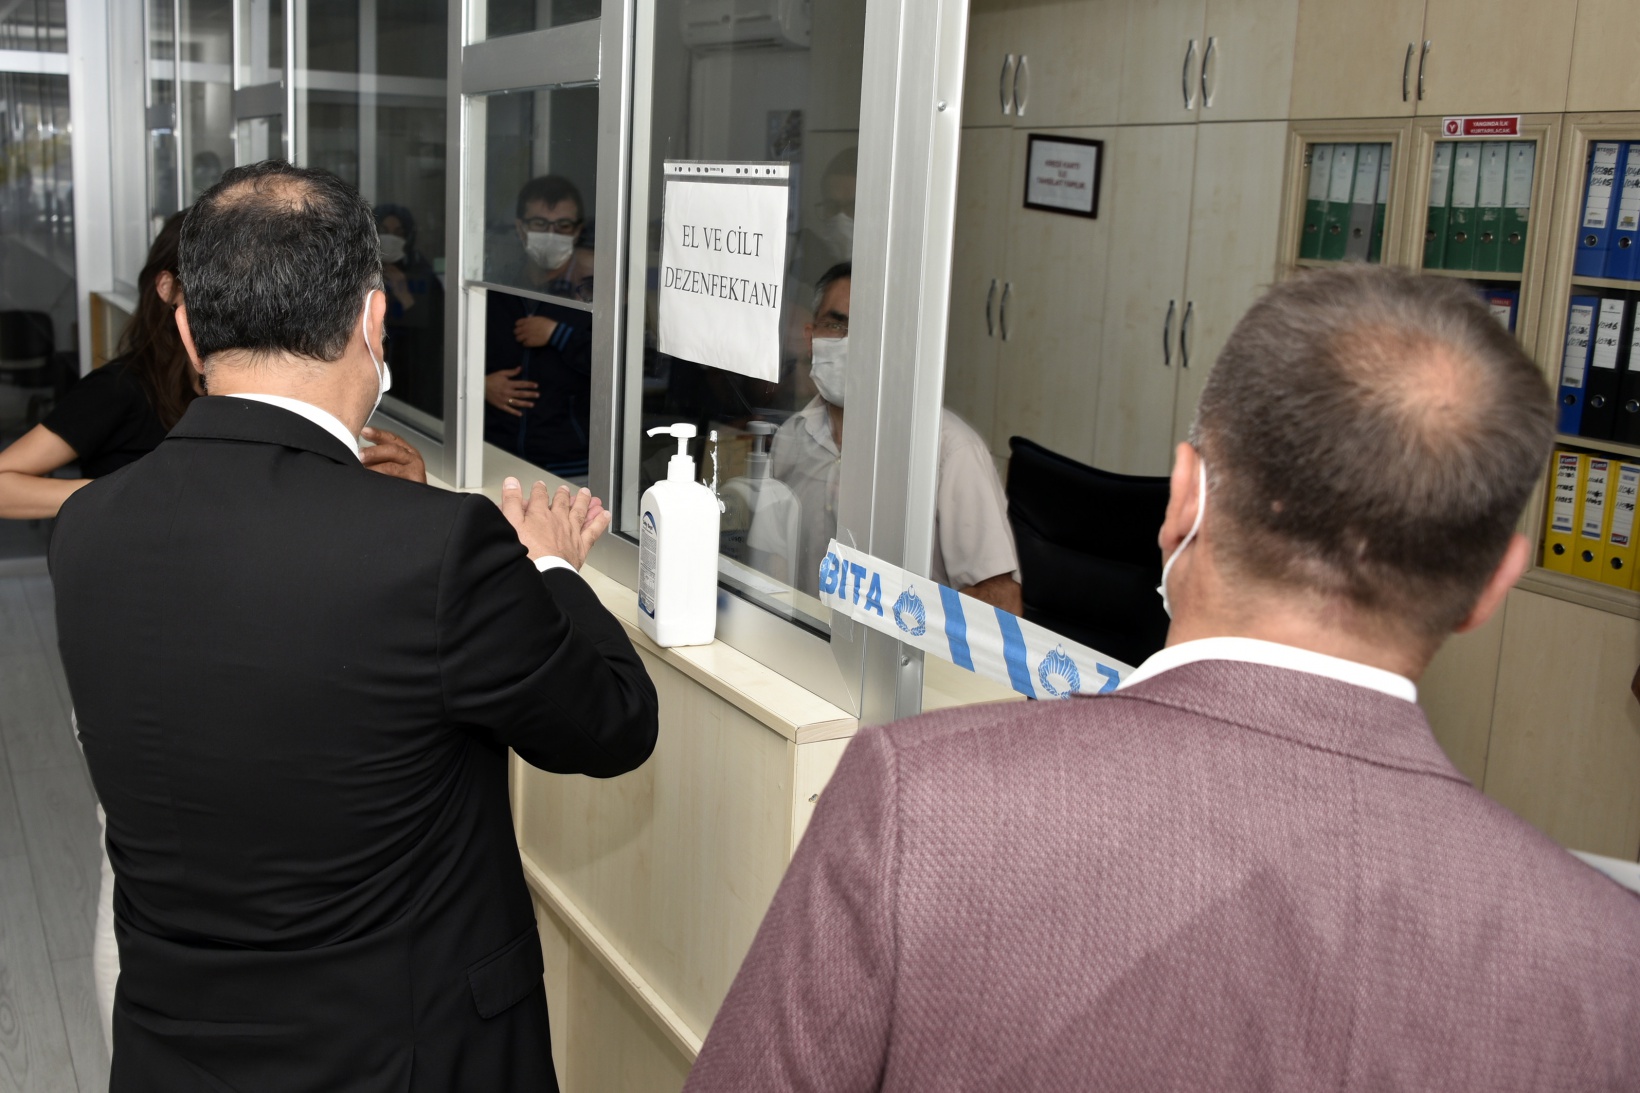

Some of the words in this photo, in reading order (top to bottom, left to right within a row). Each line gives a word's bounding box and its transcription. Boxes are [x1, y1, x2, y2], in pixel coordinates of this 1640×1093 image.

[681, 224, 699, 249] EL
[703, 227, 722, 252] VE
[726, 225, 763, 257] CİLT
[664, 266, 779, 309] DEZENFEKTANI
